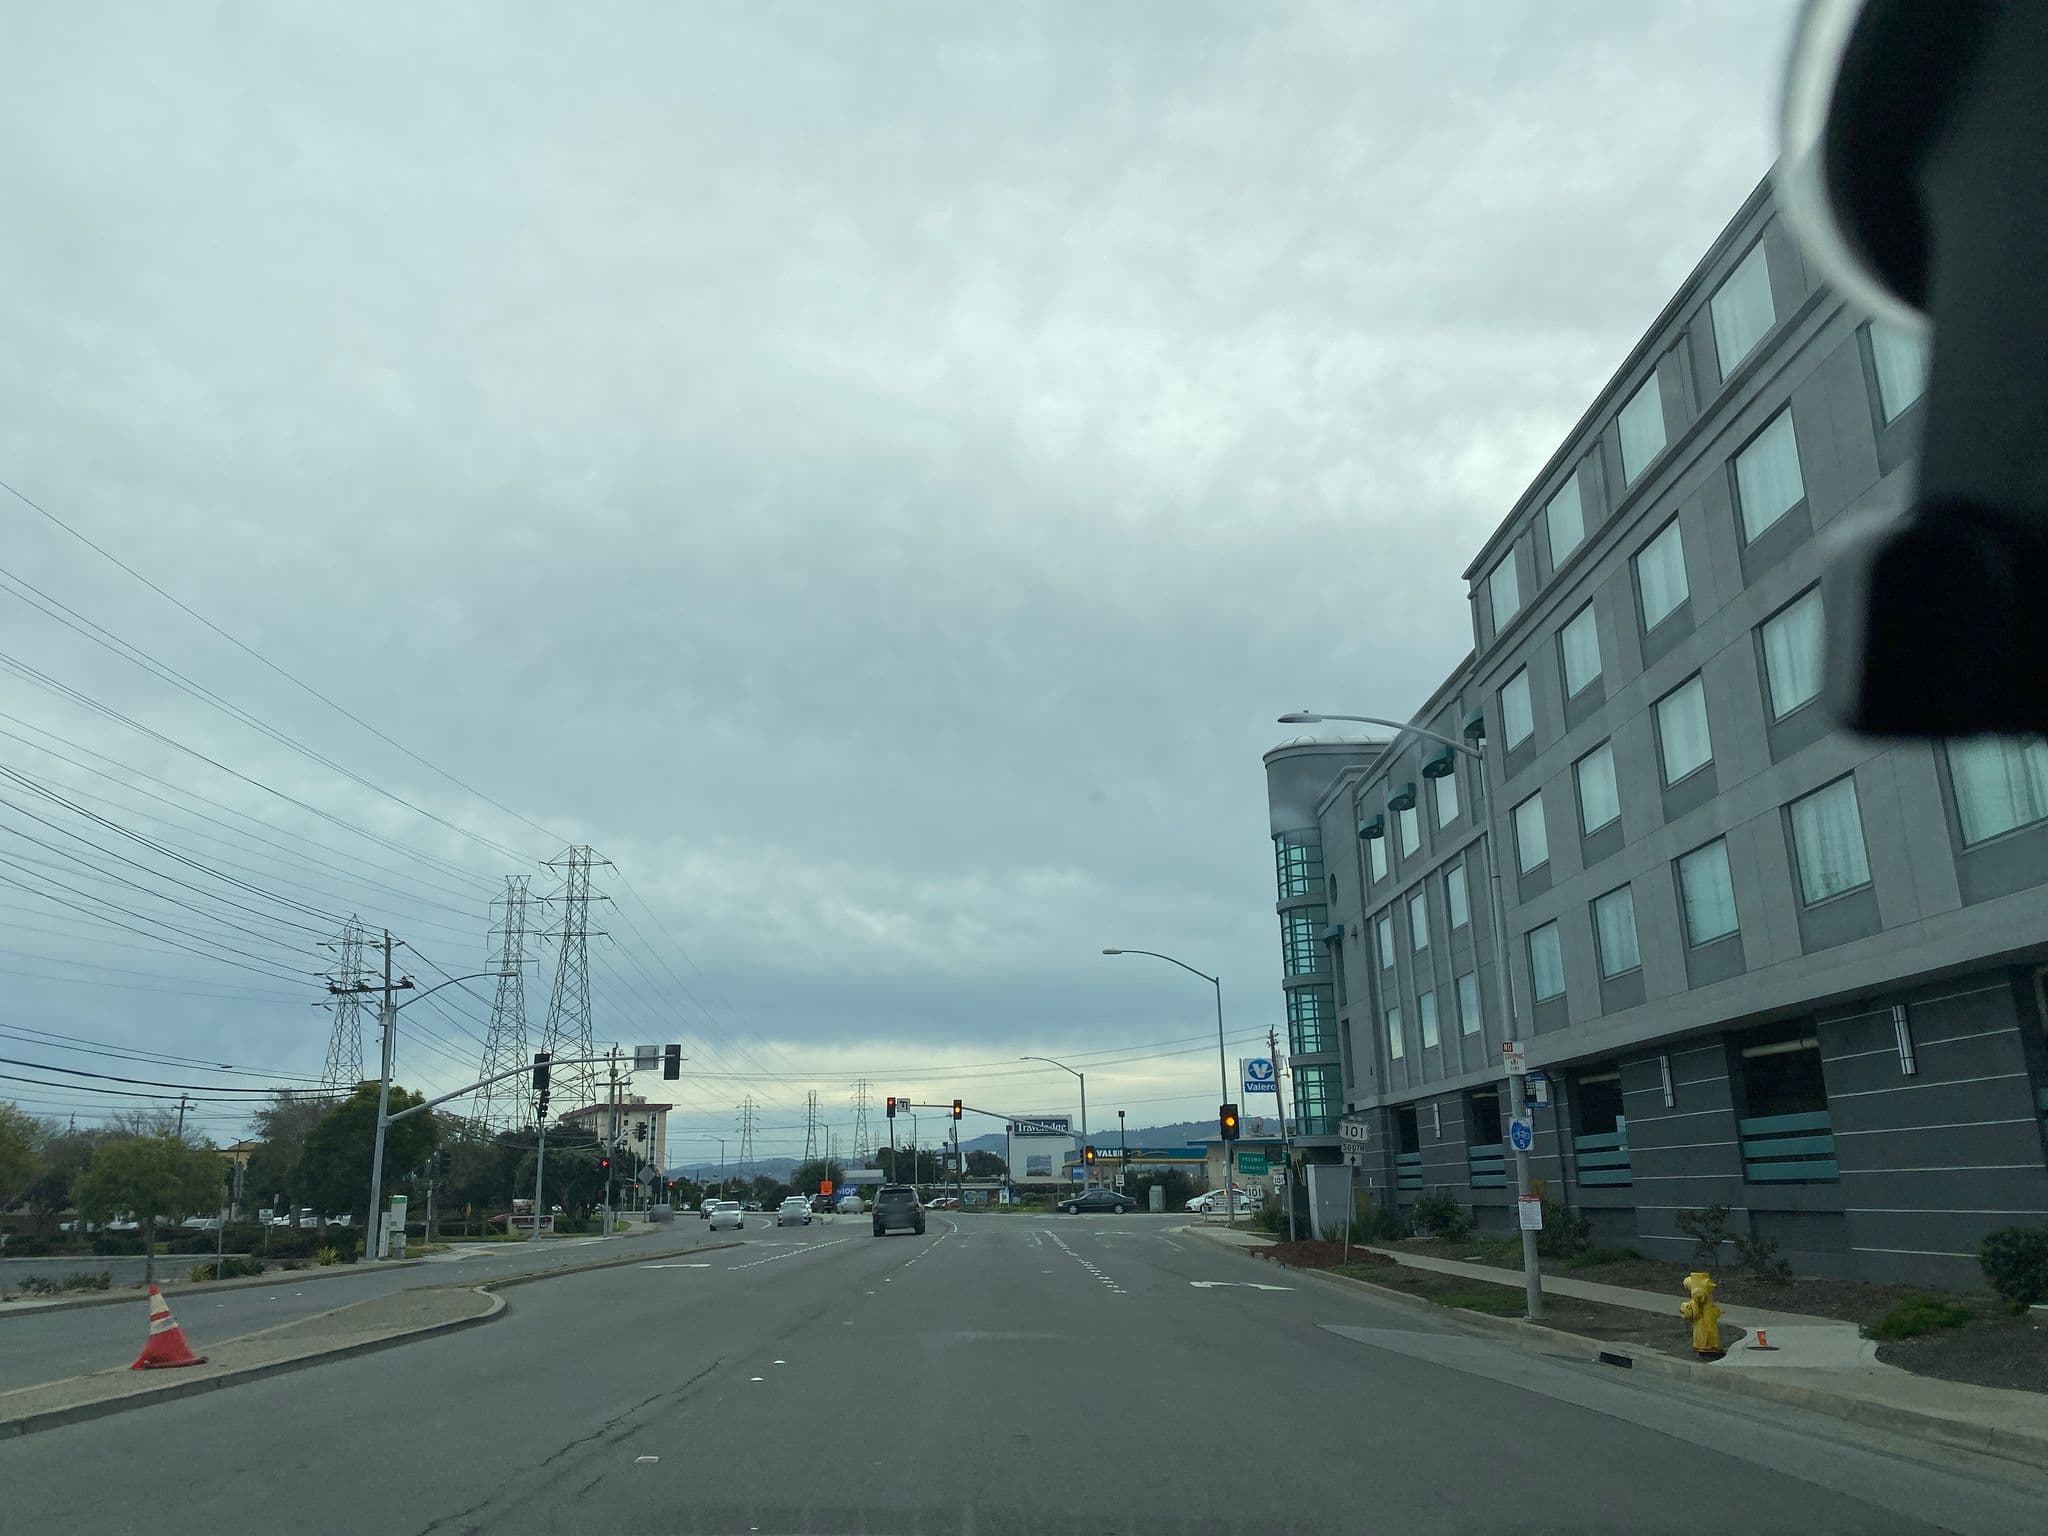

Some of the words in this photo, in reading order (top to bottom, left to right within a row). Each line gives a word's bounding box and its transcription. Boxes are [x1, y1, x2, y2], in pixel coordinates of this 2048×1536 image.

[1246, 1082, 1277, 1091] Valero
[1345, 1125, 1363, 1139] 101
[1343, 1143, 1365, 1152] SOUTH
[1248, 1188, 1262, 1197] 101
